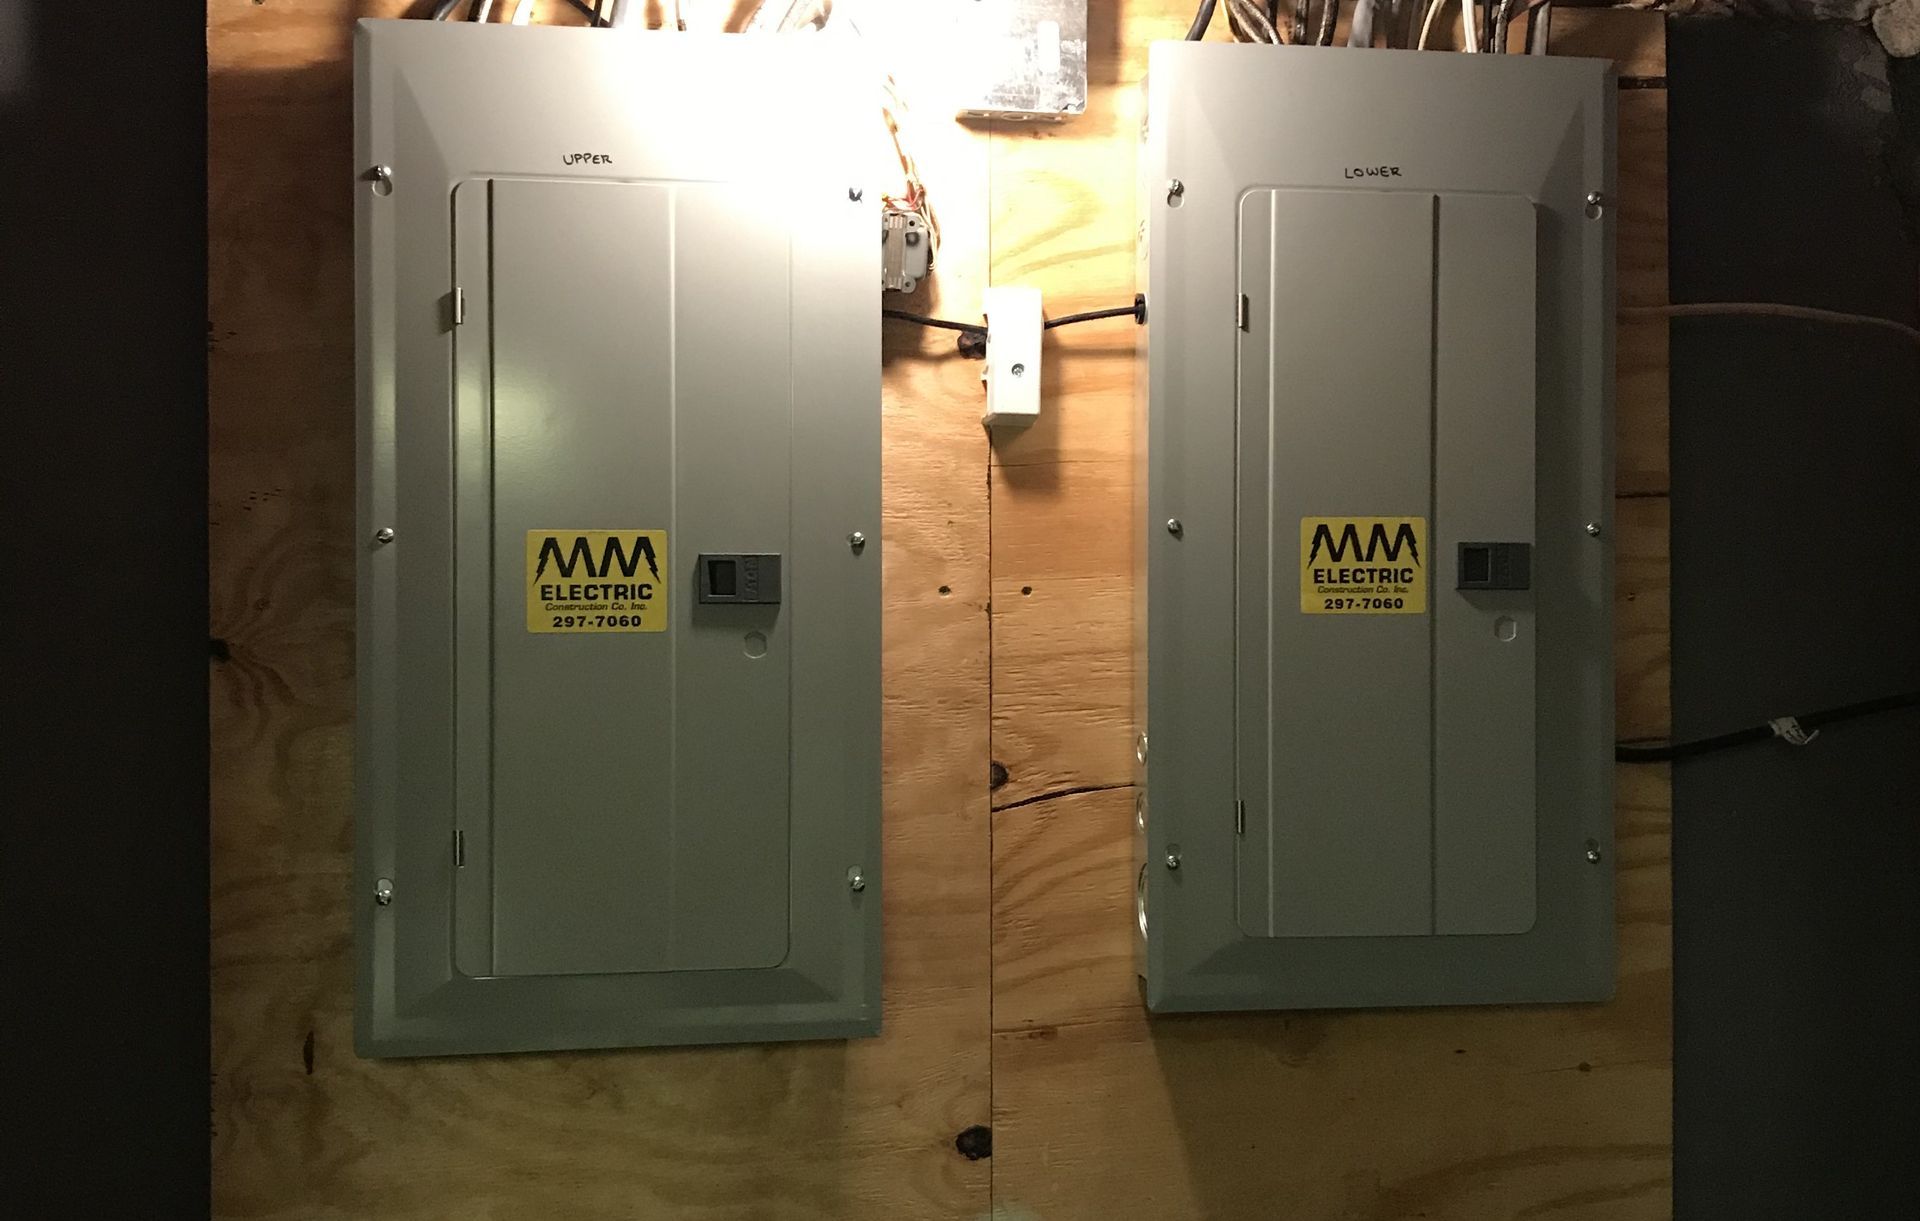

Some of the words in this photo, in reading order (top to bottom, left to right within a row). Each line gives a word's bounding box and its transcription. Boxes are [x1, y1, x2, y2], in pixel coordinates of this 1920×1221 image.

[562, 152, 613, 166] UPPER
[1344, 166, 1402, 179] LOWER
[1313, 568, 1414, 584] ELECTRIC
[540, 583, 653, 601] ELECTRIC
[1317, 585, 1375, 594] Construction
[1376, 585, 1391, 594] Co.
[1393, 585, 1409, 594] Inc.
[544, 602, 609, 611] Construction
[610, 602, 627, 611] Co.
[629, 602, 648, 611] Inc.
[1324, 598, 1404, 610] 297-7060
[552, 615, 642, 628] 297-7060
